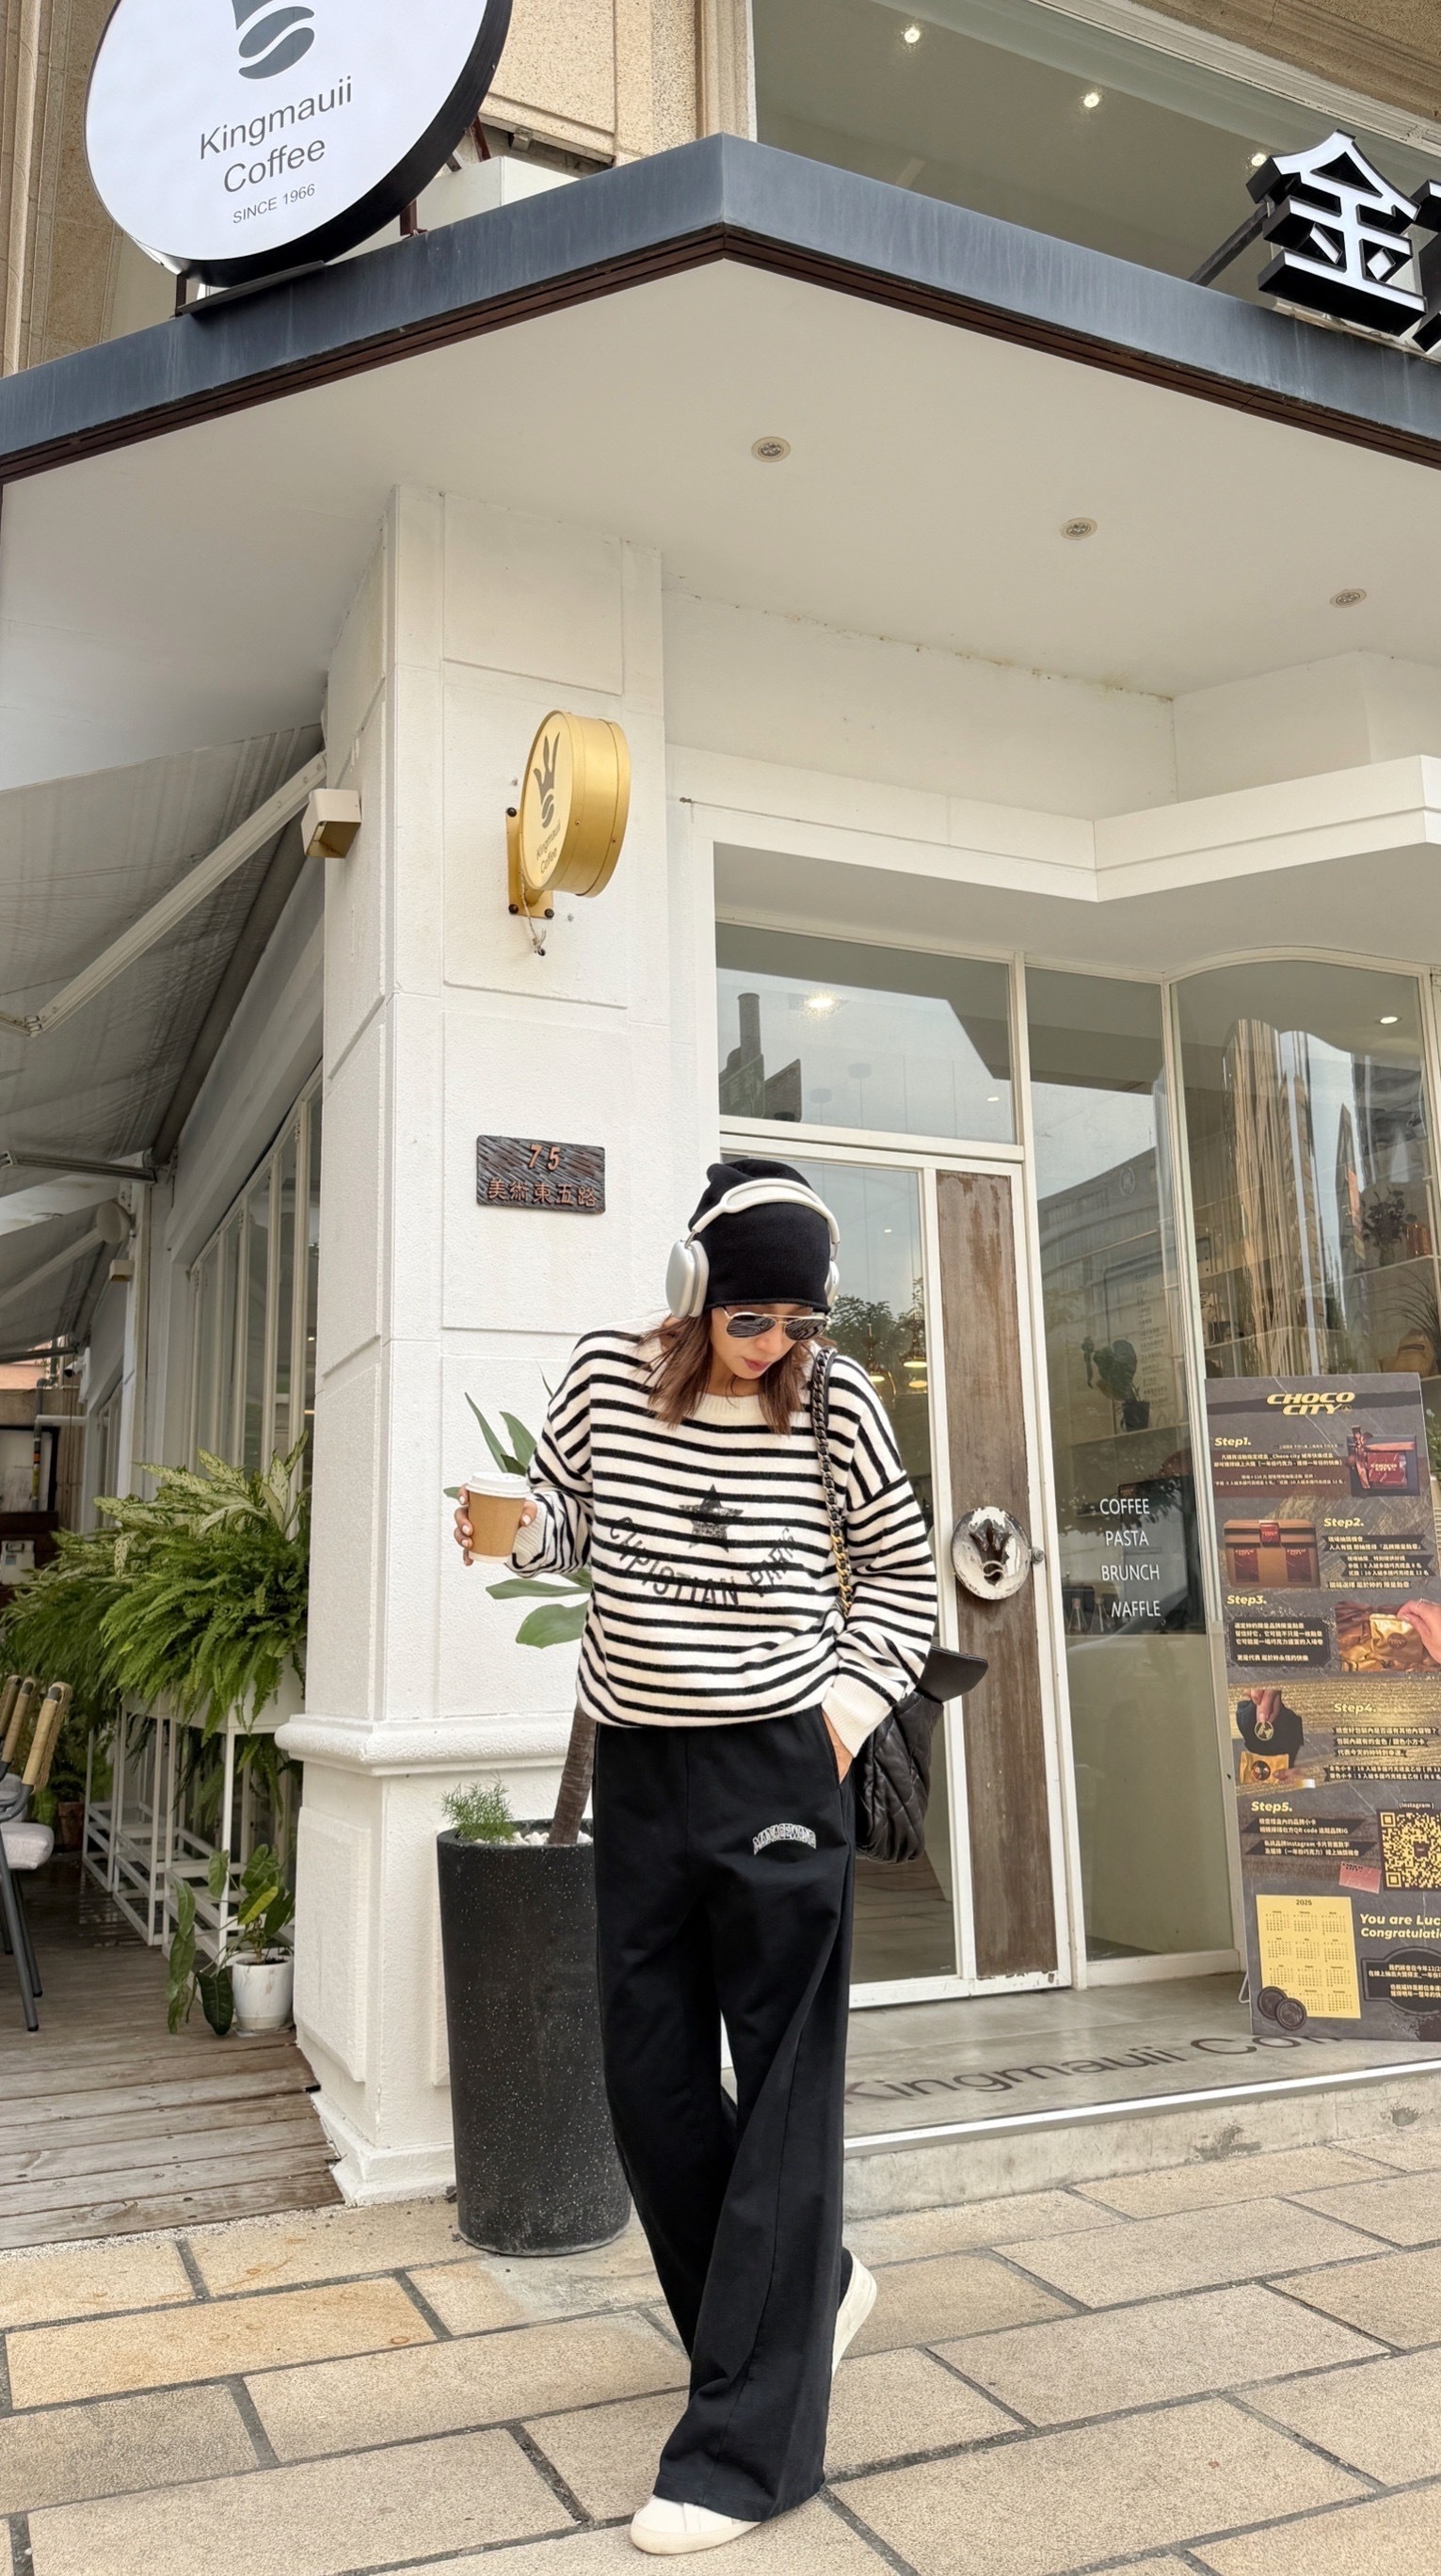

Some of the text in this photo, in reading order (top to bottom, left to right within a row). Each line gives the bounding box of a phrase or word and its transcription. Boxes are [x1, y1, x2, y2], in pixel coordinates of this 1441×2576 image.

[200, 75, 352, 160] Kingmauii
[224, 139, 326, 193] Coffee
[232, 184, 315, 224] SINCE 1966
[528, 1144, 561, 1171] 75
[488, 1177, 598, 1208] 美術東五路
[1267, 1392, 1355, 1404] CHOCO
[1283, 1403, 1342, 1416] CITY
[1214, 1437, 1252, 1448] Step1.
[1099, 1498, 1150, 1514] COFFEE
[1323, 1517, 1364, 1528] Step2.
[1105, 1530, 1149, 1546] PASTA
[1101, 1564, 1160, 1581] BRUNCH
[1226, 1594, 1267, 1606] Step3.
[1334, 1703, 1377, 1714] Step4.
[1251, 1801, 1292, 1814] Step5.
[1360, 1913, 1385, 1925] You
[1389, 1915, 1413, 1926] are
[1361, 1928, 1441, 1940] Congratulati
[1191, 2036, 1343, 2056] Co
